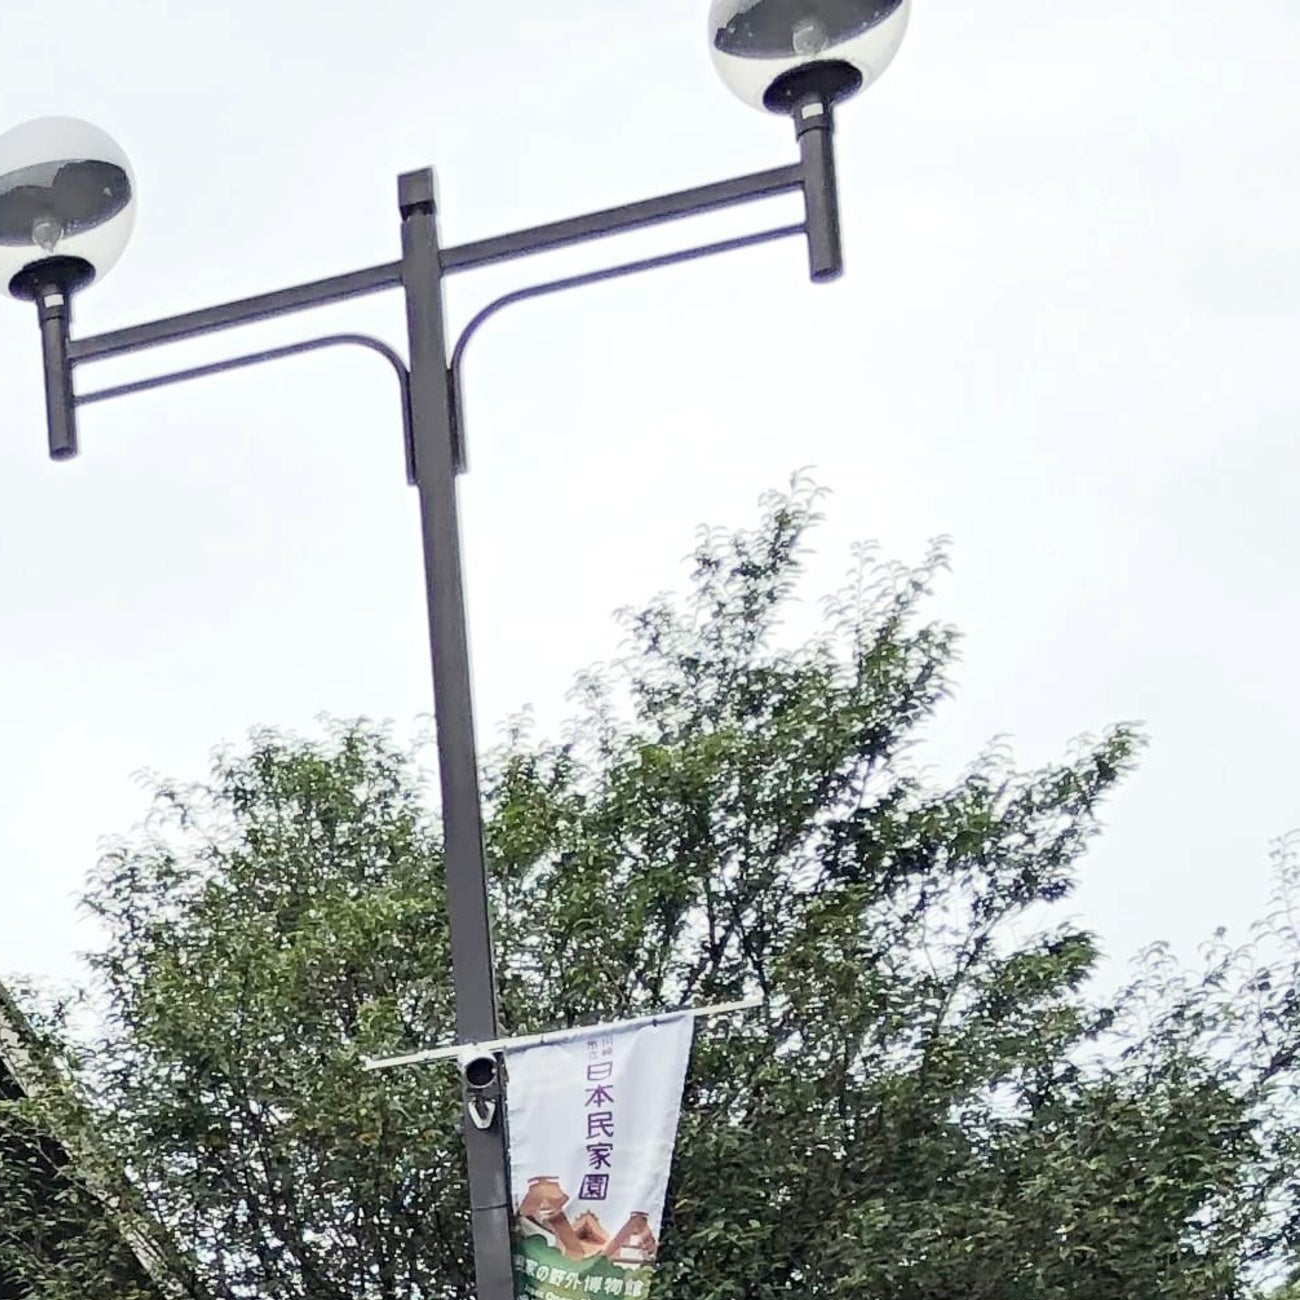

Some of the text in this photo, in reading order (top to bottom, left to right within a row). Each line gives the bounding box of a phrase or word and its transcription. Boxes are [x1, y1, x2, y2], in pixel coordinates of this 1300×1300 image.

[578, 1061, 614, 1200] 日本民家園
